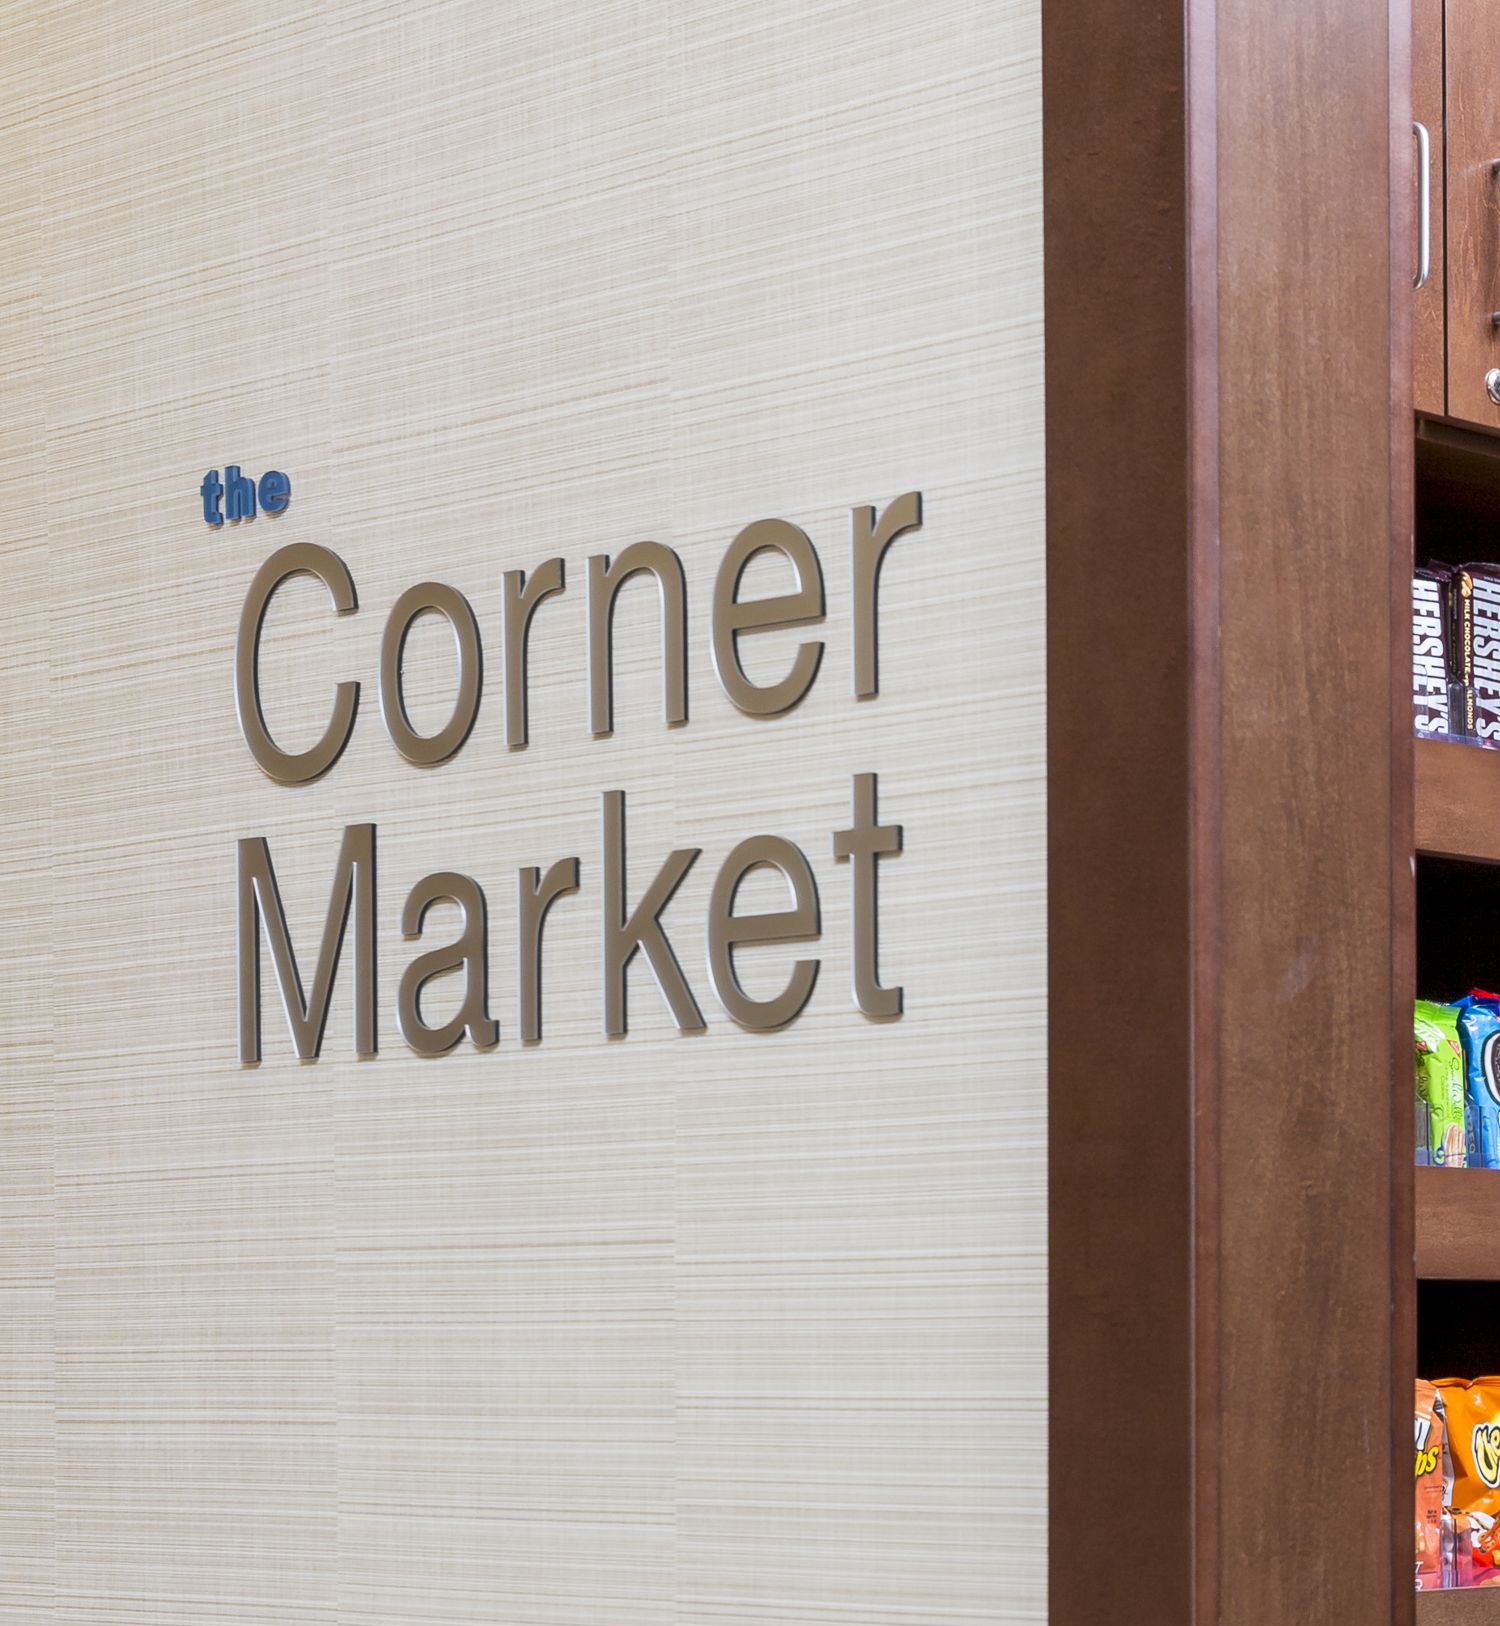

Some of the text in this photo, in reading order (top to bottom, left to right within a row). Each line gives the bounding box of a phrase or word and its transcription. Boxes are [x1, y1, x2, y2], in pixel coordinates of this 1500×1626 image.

[200, 465, 291, 526] the
[234, 490, 923, 785] Corner
[236, 772, 905, 1066] Market
